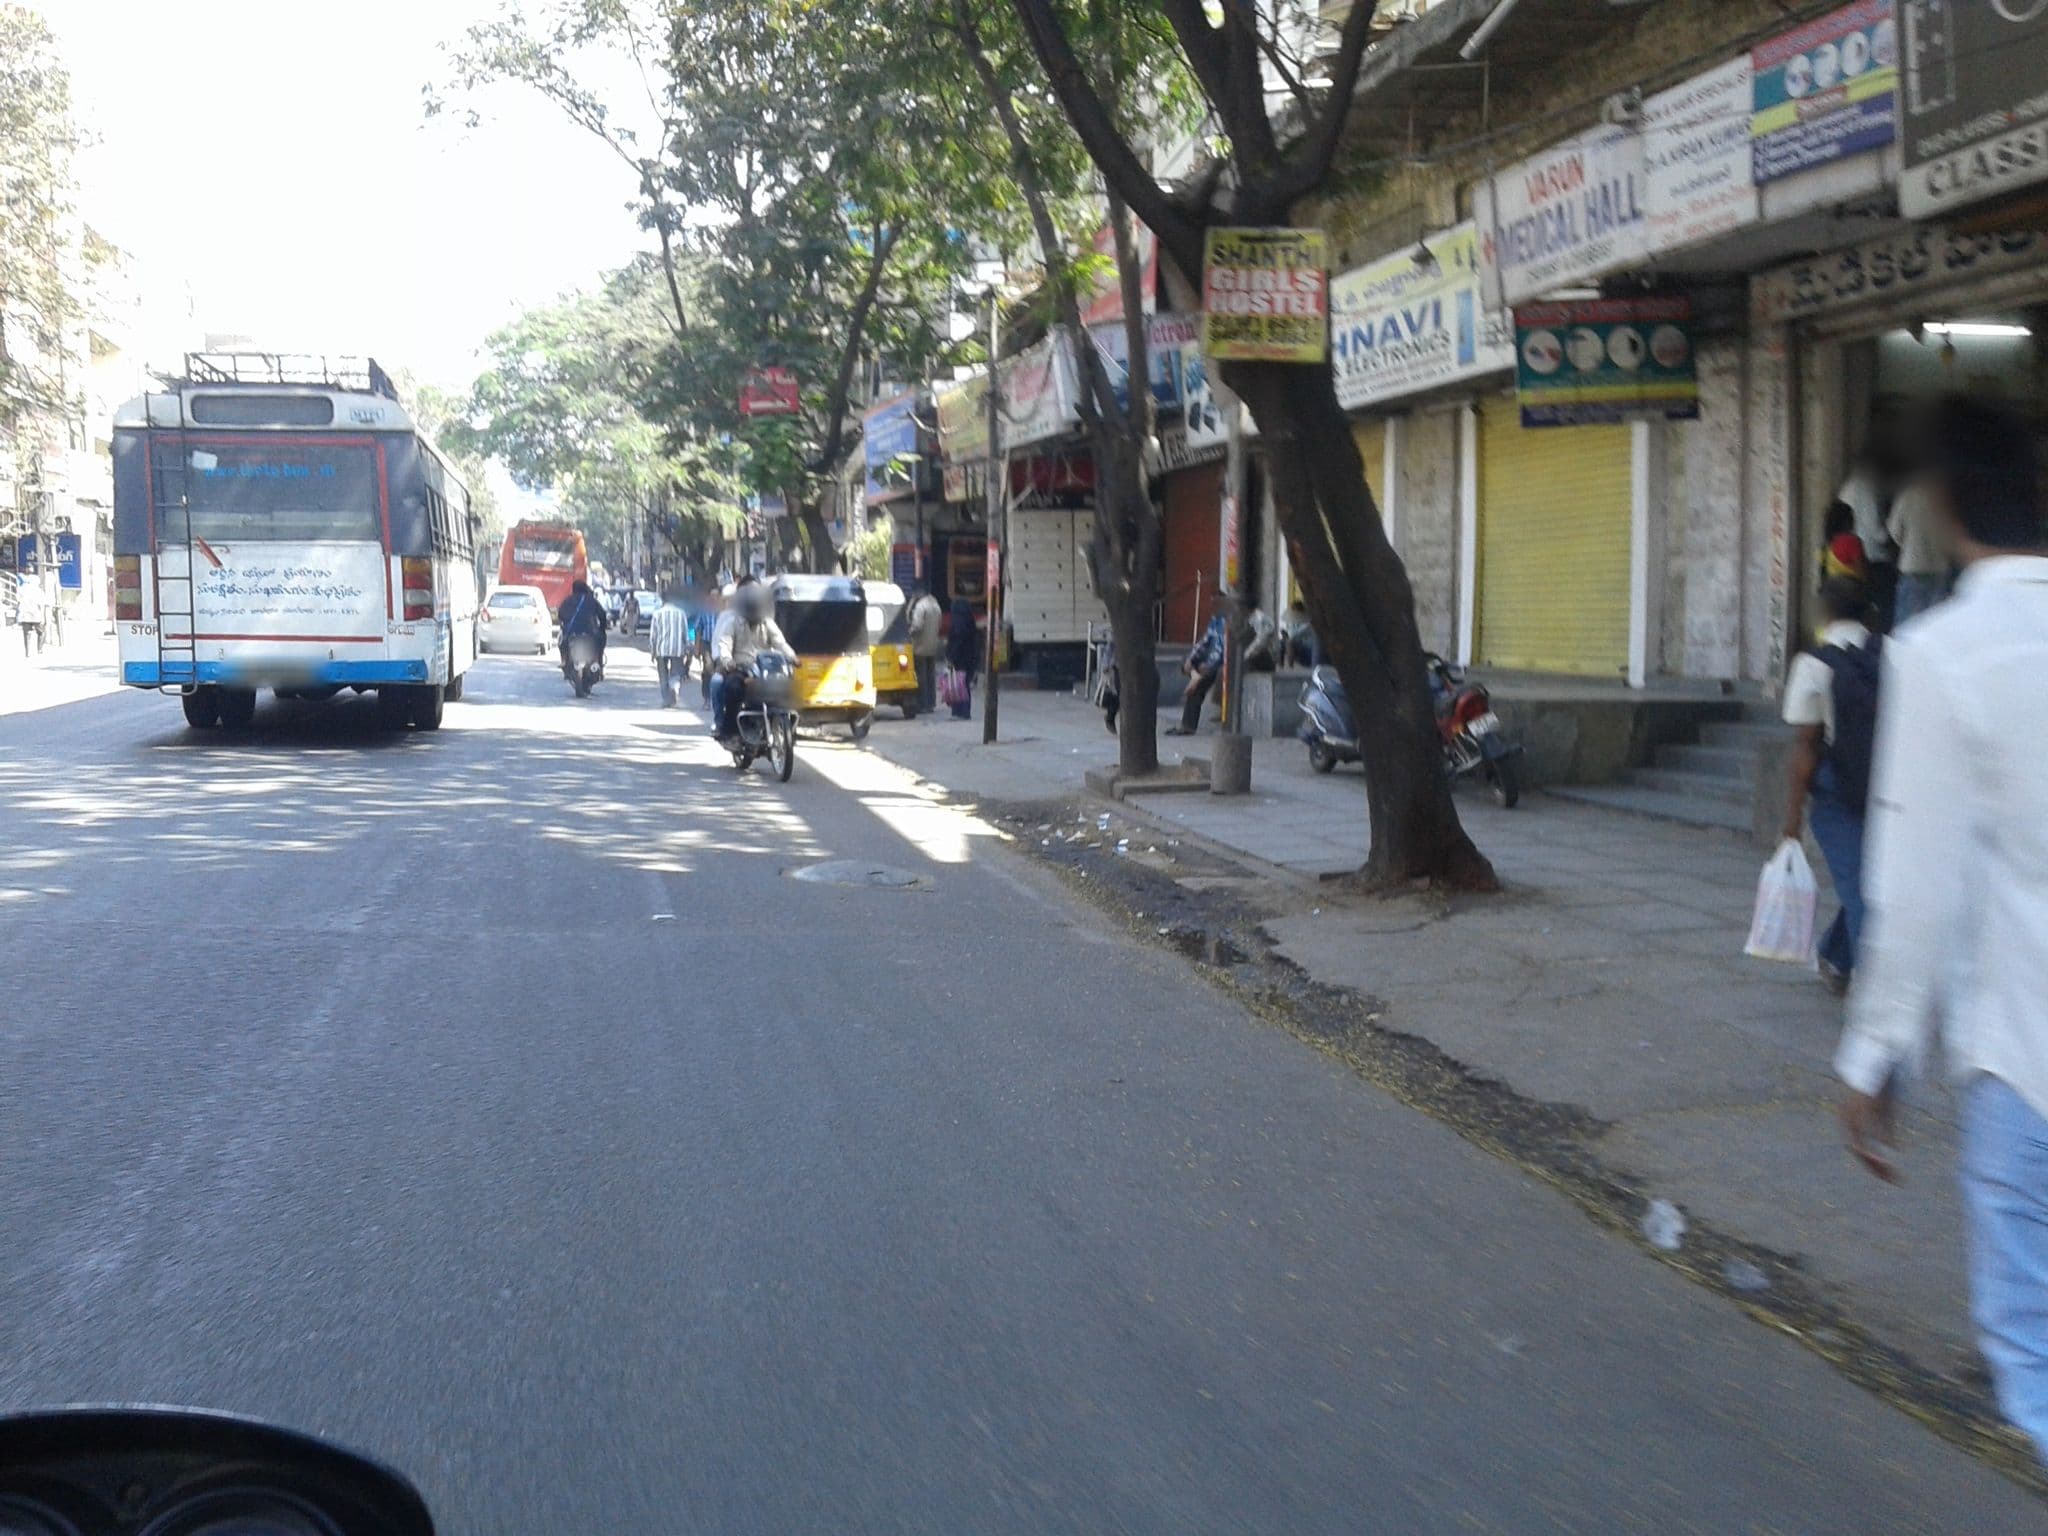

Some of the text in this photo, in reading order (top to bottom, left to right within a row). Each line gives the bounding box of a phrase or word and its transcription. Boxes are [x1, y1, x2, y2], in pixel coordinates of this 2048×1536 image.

[1525, 153, 1585, 205] VARUN
[1927, 126, 2048, 199] CLASS
[1499, 198, 1581, 268] MEDICAL
[1582, 170, 1645, 240] HALL
[1210, 267, 1321, 291] GIRLS
[1210, 290, 1319, 314] HOSTEL
